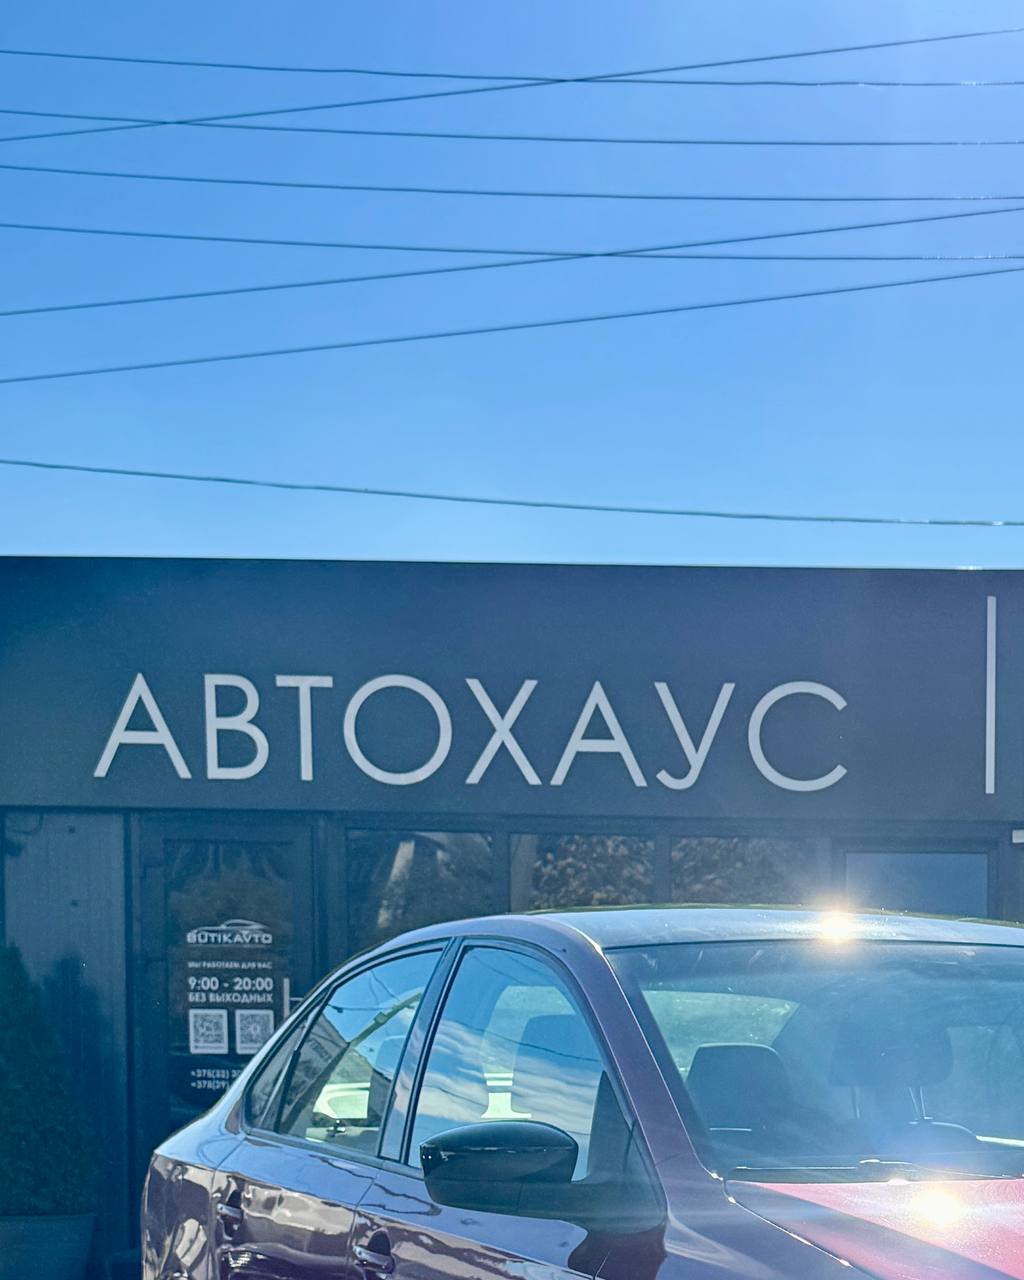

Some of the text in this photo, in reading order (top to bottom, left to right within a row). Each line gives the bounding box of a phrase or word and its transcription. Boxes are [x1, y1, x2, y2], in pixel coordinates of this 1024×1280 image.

[93, 672, 848, 792] АВТОХАУС
[187, 932, 273, 944] BUTIKAVTO
[188, 976, 220, 991] 9:00
[233, 976, 274, 991] 20:00
[188, 991, 273, 1004] БЕЗ ВЫХОДНЫХ
